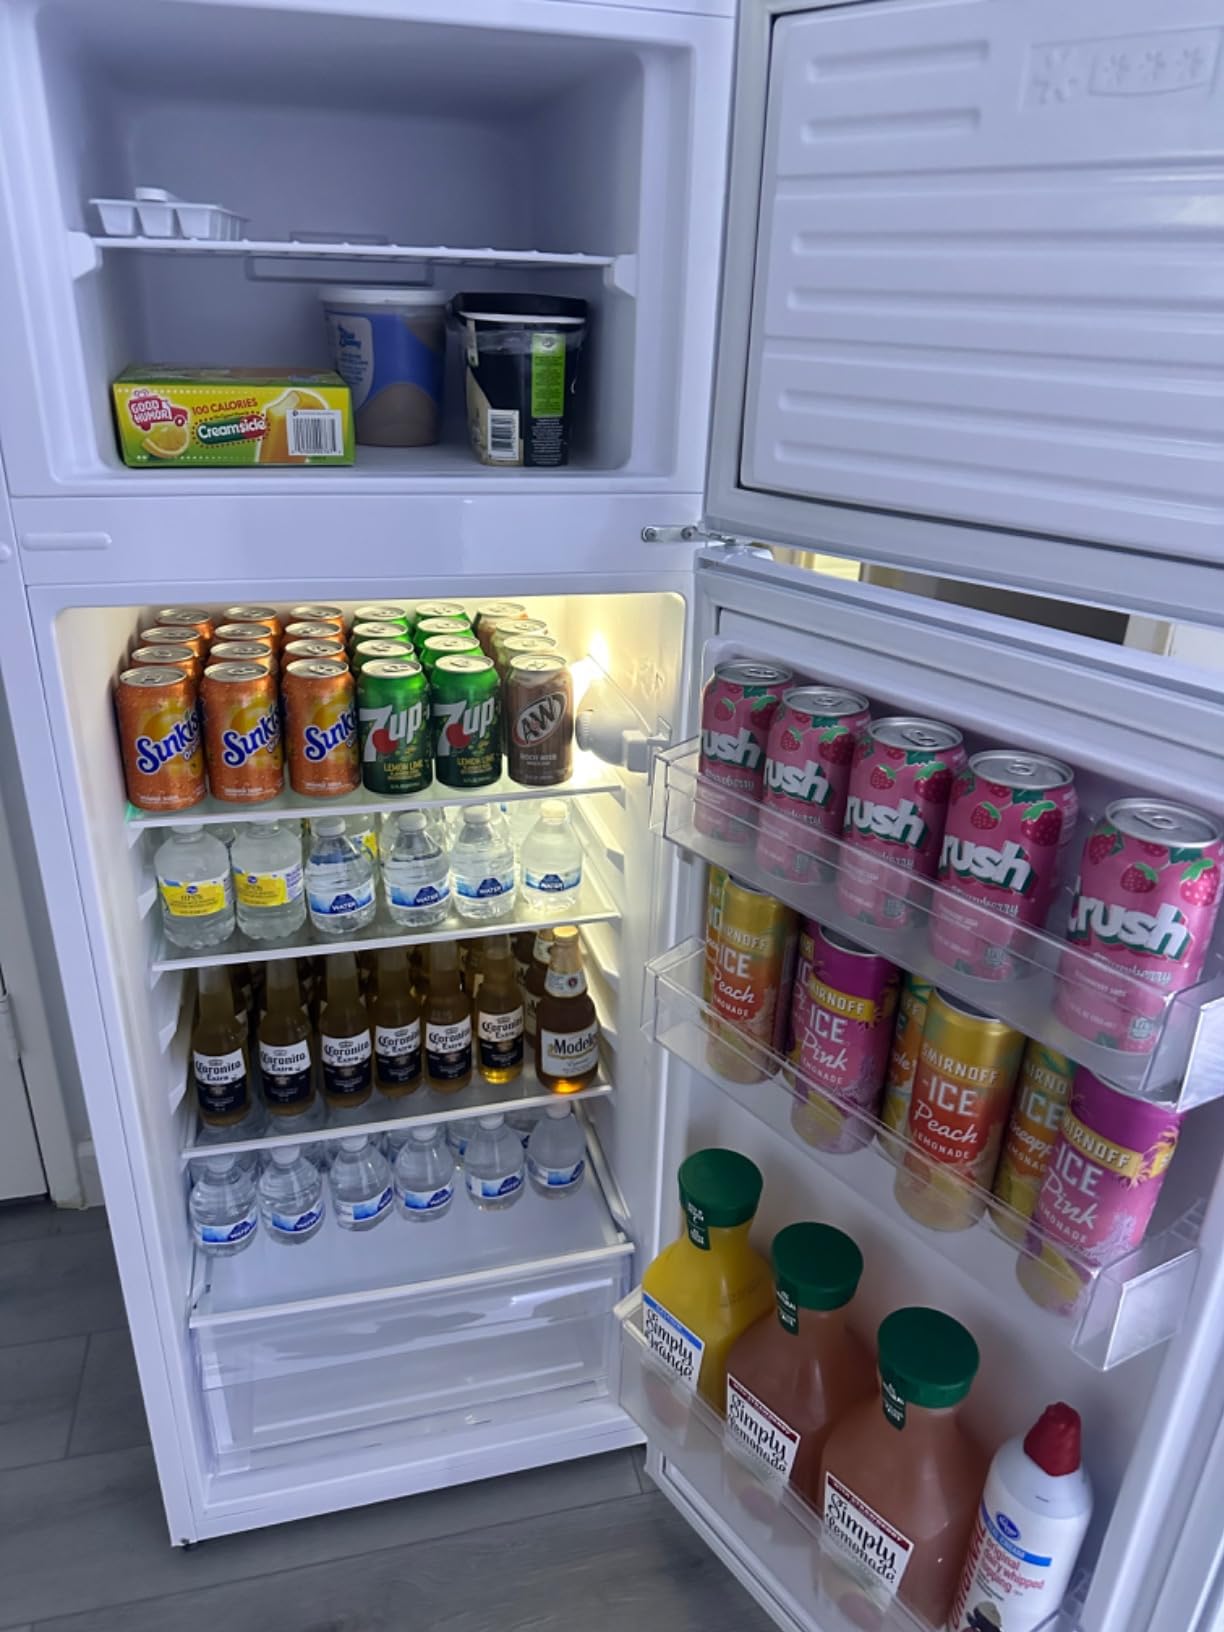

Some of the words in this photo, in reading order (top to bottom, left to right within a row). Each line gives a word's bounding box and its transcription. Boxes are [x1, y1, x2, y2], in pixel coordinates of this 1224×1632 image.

[131, 400, 160, 413] GOOD
[192, 404, 209, 415] 100
[211, 397, 258, 412] CALORIES
[1069, 895, 1189, 957] rush
[809, 1004, 848, 1044] ICE
[802, 1026, 849, 1071] Pink
[929, 1075, 977, 1117] ICE
[915, 1099, 978, 1143] Peach
[914, 1129, 970, 1160] LEMONADE
[1056, 1143, 1103, 1197] ICE
[1041, 1168, 1099, 1229] Pink
[646, 1308, 692, 1366] Simply
[730, 1393, 787, 1460] Simply
[828, 1492, 897, 1568] Simply
